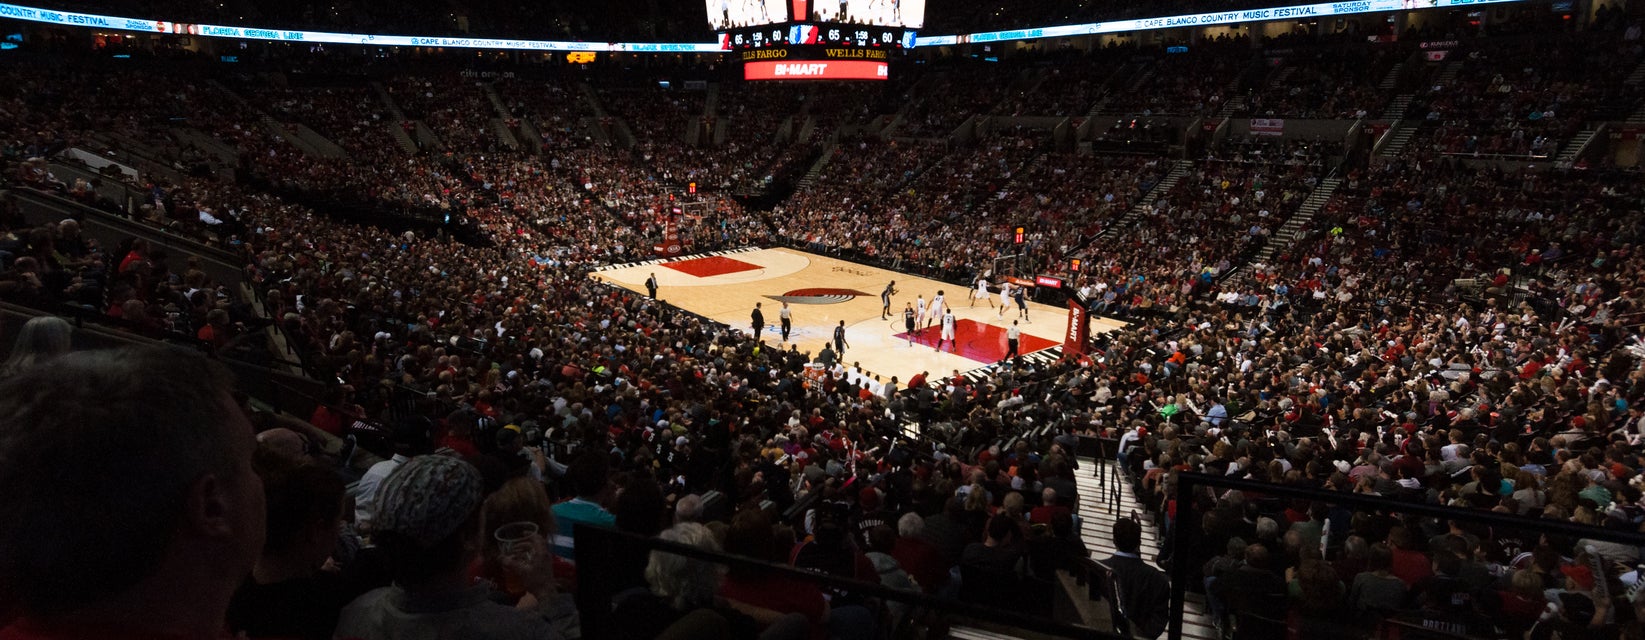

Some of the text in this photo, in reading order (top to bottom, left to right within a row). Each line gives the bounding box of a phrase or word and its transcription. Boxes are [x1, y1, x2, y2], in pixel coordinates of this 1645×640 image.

[1332, 1, 1371, 9] SATURDAY
[0, 5, 109, 26] COUNTRY MUSIC FESTIVAL
[1144, 6, 1317, 28] CAPE BLANCO COUNTRY MUSIC FESTIVAL
[203, 26, 304, 40] FLORIDA GEORGIA LINE
[735, 34, 743, 45] 65
[753, 32, 763, 41] 1:58
[773, 30, 781, 41] 60
[828, 29, 840, 41] 65
[855, 31, 868, 40] 1:58
[882, 32, 893, 43] 60
[756, 49, 787, 58] FARGO
[825, 49, 864, 58] WELLS
